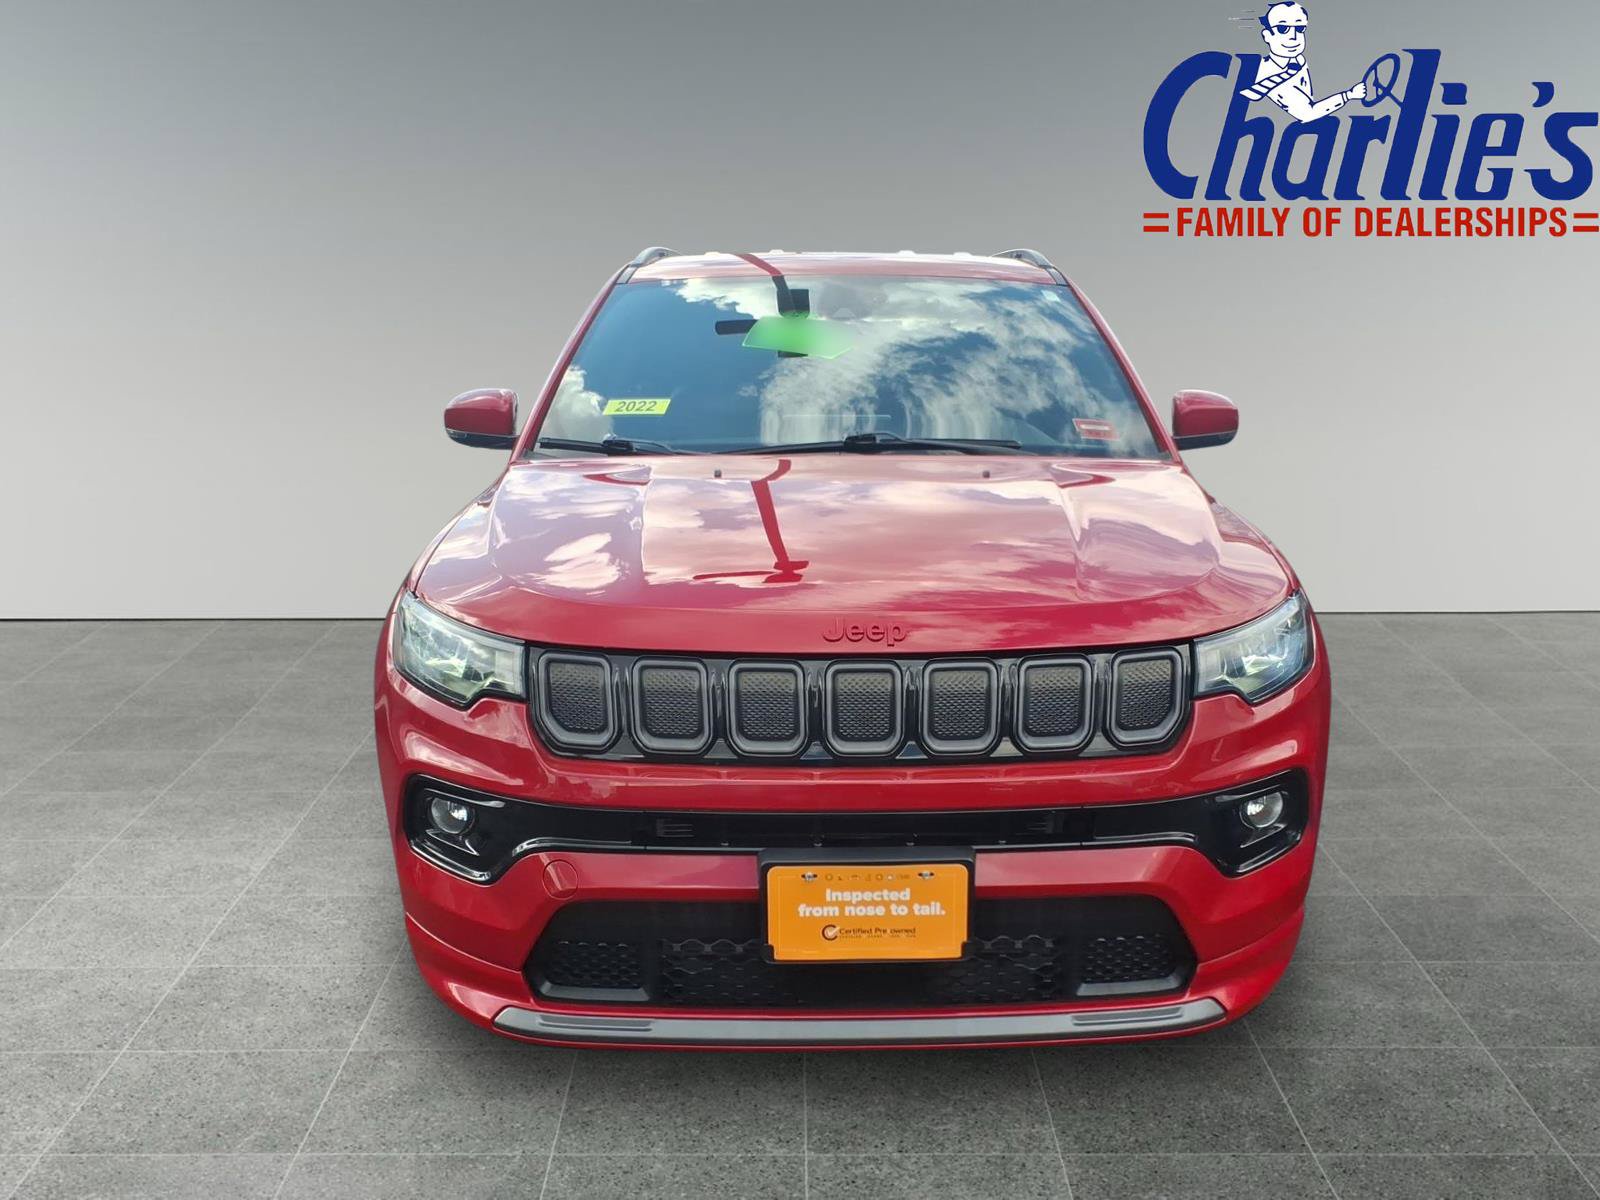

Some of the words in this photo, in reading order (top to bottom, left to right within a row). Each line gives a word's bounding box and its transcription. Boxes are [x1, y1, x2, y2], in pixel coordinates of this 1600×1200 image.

[614, 401, 657, 412] 2022
[822, 617, 907, 647] Jeep
[825, 888, 911, 904] Inspected
[798, 904, 840, 917] from
[844, 904, 886, 916] nose
[890, 903, 909, 915] to
[913, 902, 946, 916] tail.
[839, 926, 873, 935] Certified
